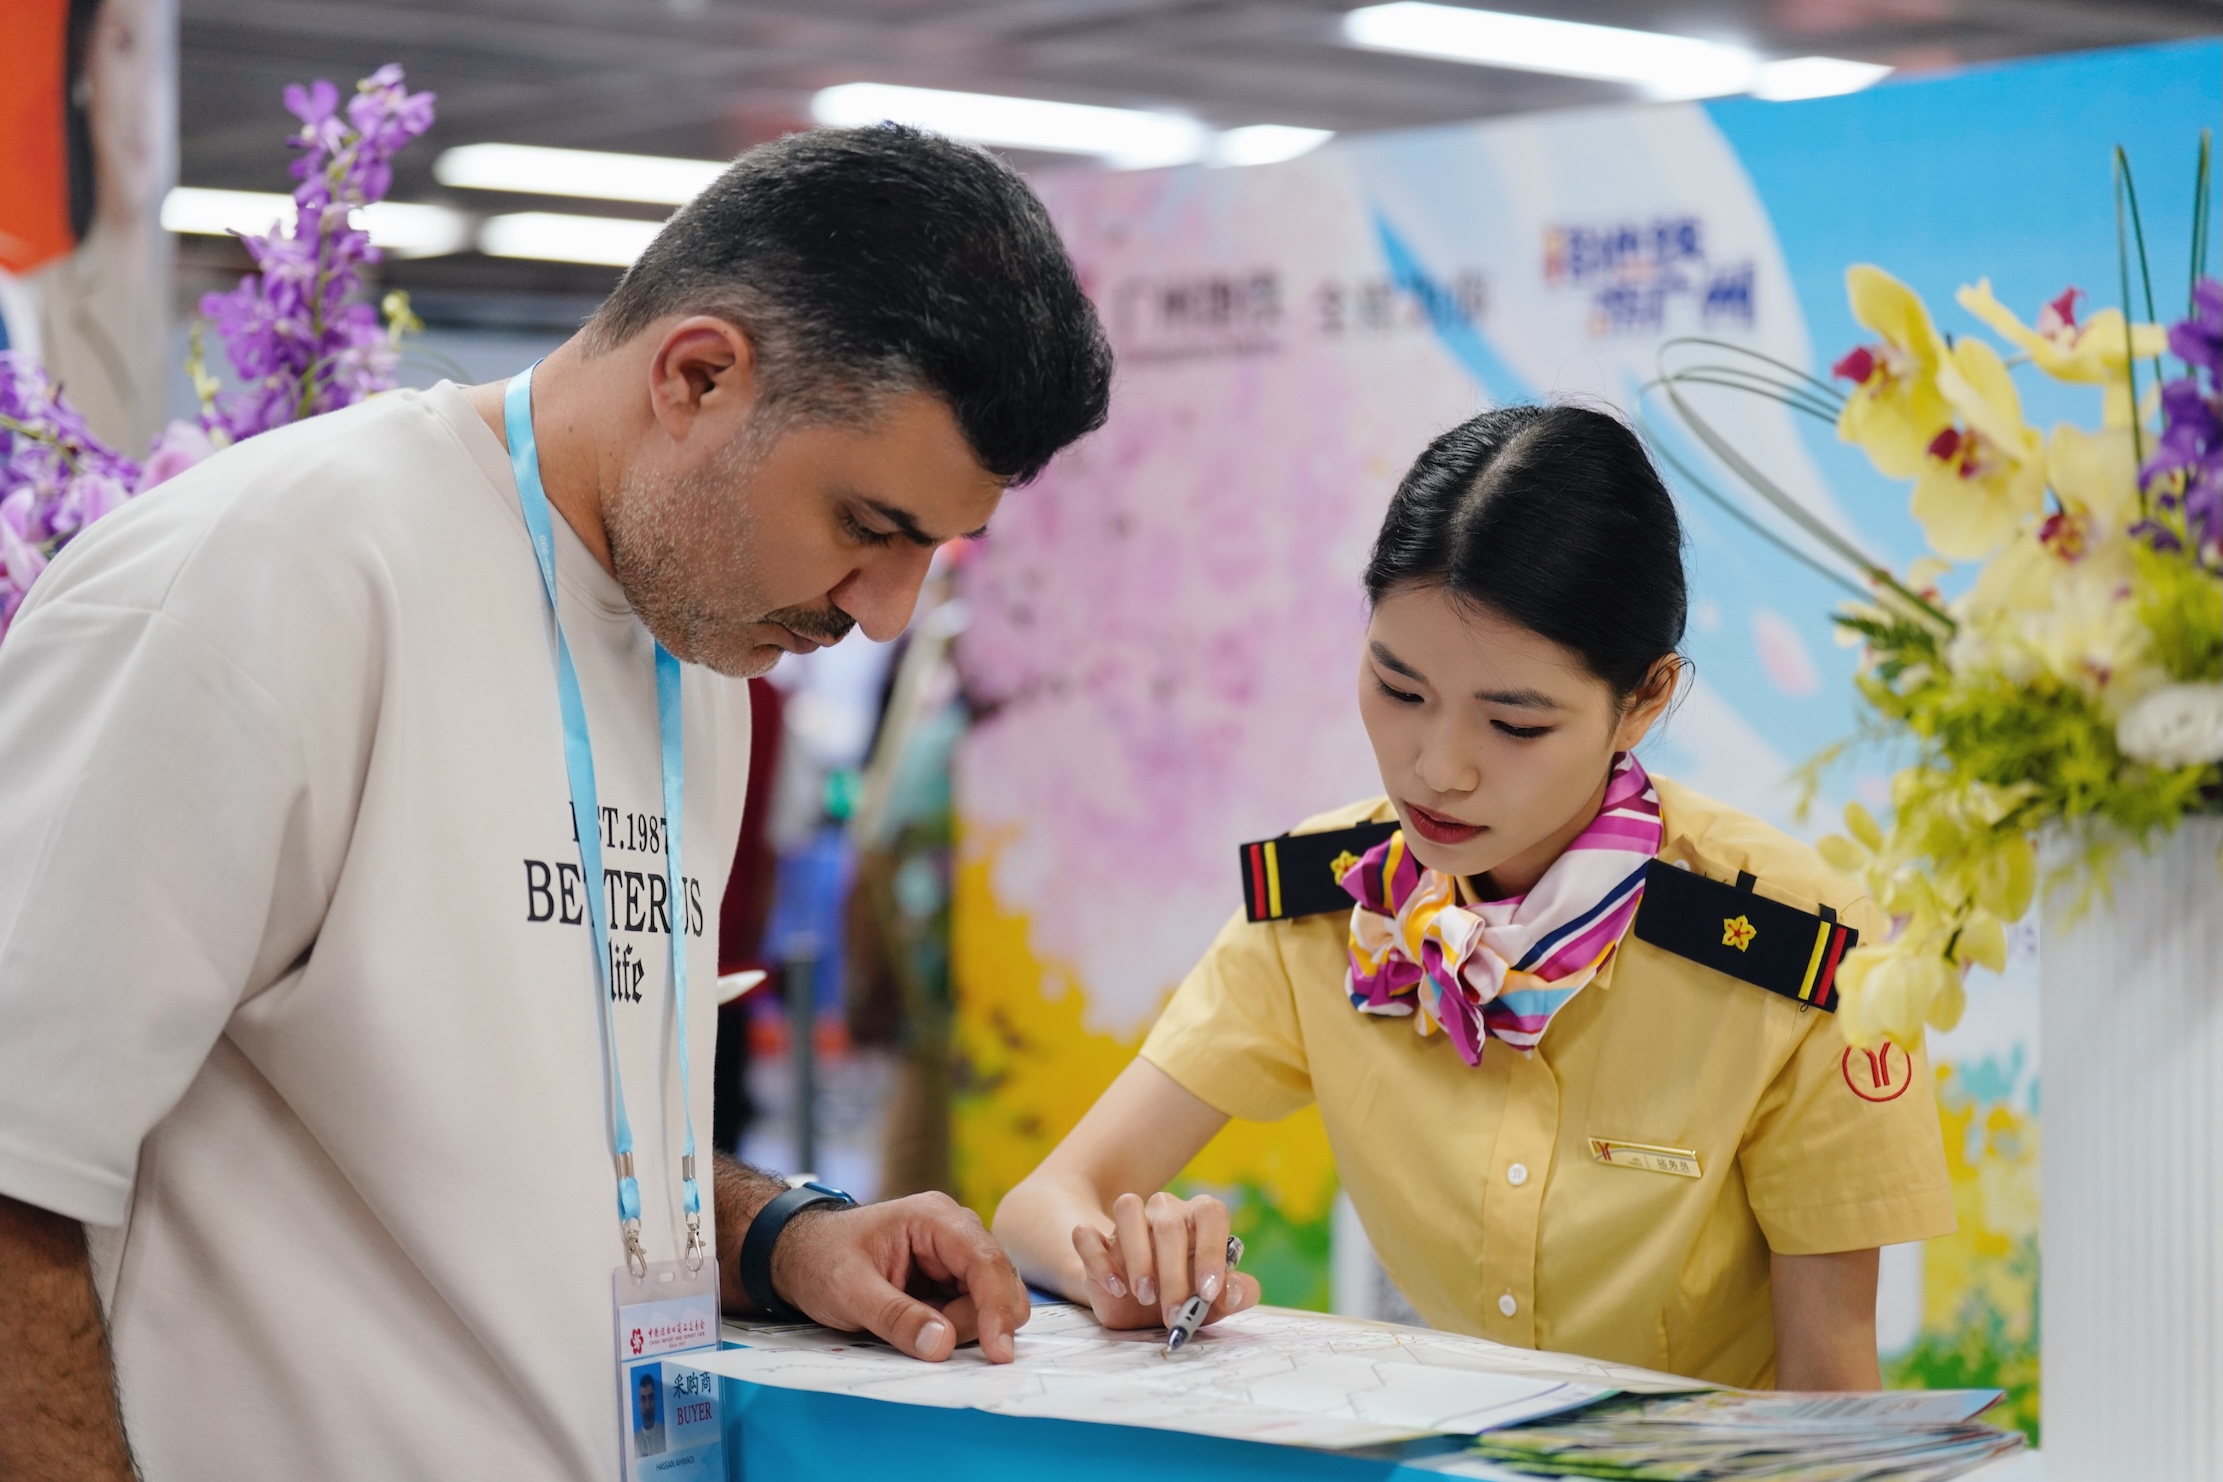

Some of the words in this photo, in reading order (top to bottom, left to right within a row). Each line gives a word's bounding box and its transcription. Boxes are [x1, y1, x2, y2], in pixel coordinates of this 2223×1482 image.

[569, 801, 669, 855] T.1987
[523, 859, 704, 937] BETERS
[608, 937, 645, 1004] life
[673, 1371, 711, 1399] 采购商
[676, 1402, 712, 1426] BUYER
